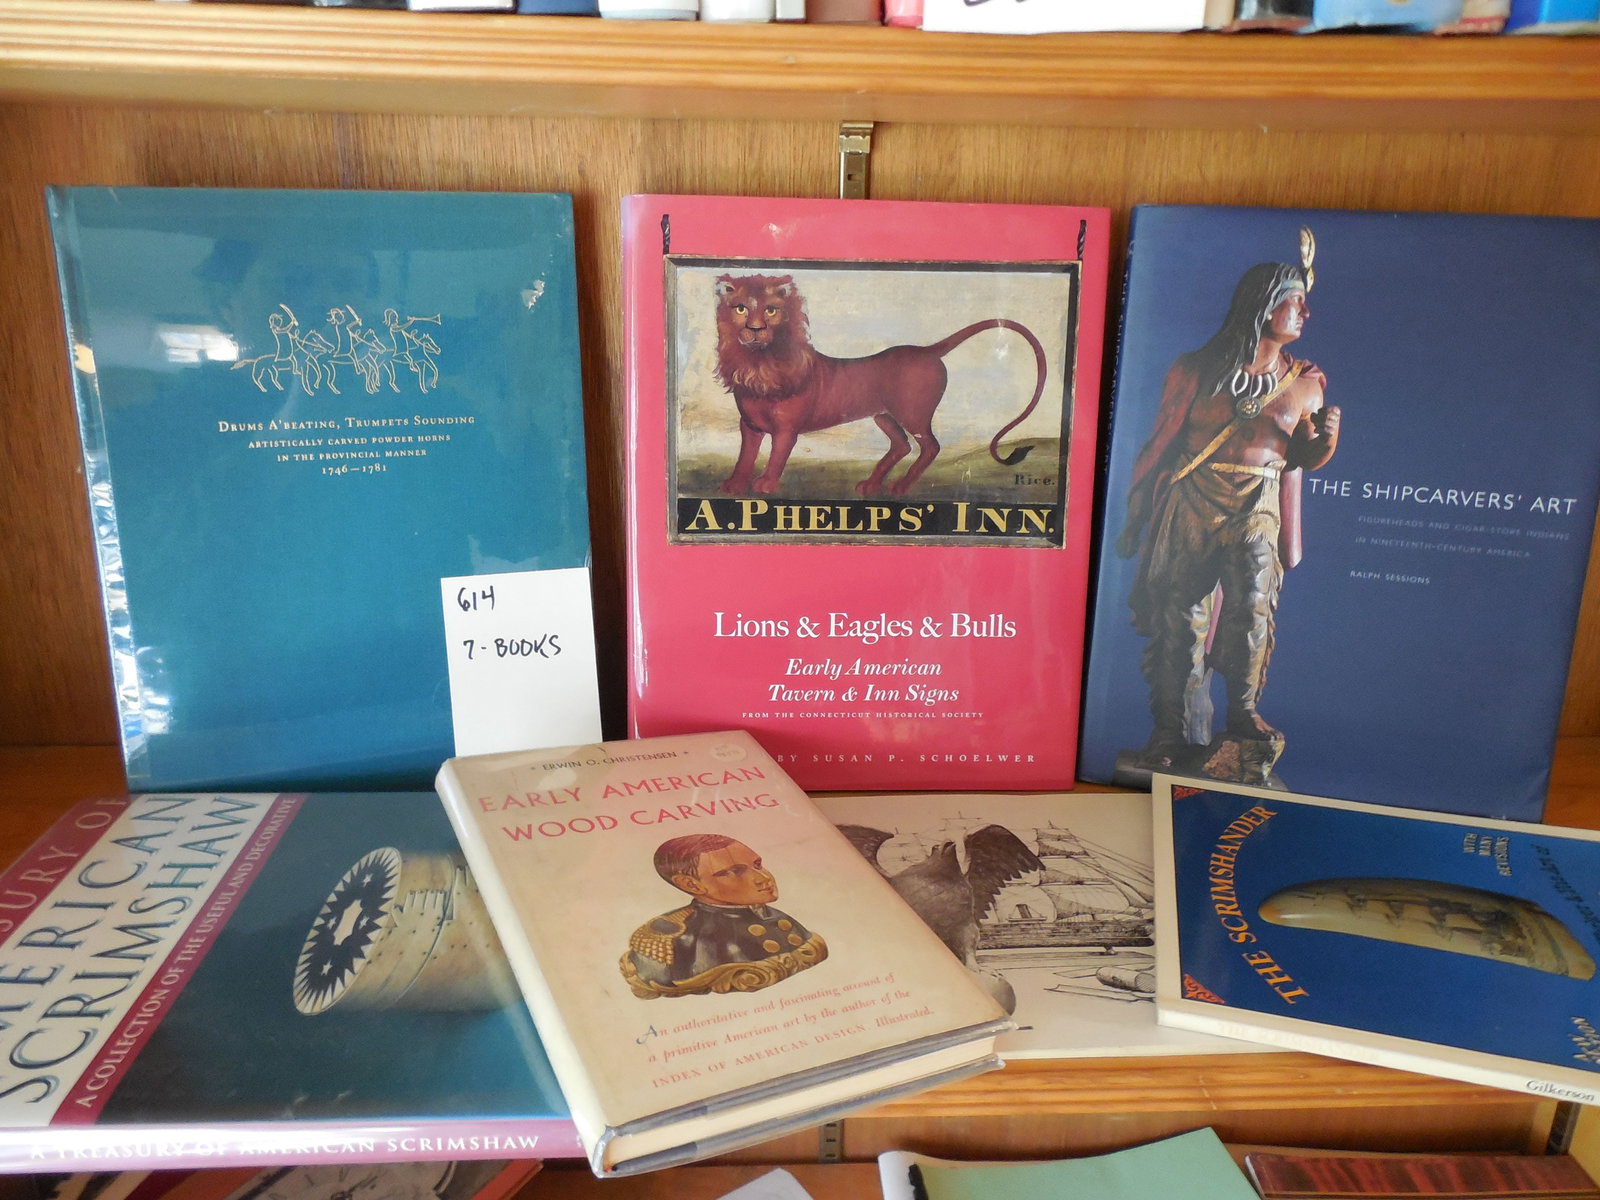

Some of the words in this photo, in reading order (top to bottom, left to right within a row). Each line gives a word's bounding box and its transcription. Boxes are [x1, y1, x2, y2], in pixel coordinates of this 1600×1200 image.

[217, 420, 264, 433] DRUMS
[344, 415, 409, 428] TRUMPETS
[413, 414, 476, 427] SOUNDING
[248, 438, 324, 449] ARTISTICALLY
[327, 436, 368, 446] CARVED
[372, 435, 414, 444] POWDER
[417, 433, 451, 442] HORNS
[276, 453, 289, 463] IN
[293, 452, 315, 462] THE
[319, 450, 381, 460] PROVINCIAL
[385, 448, 427, 458] MANNER
[1014, 473, 1056, 486] Rice.
[1308, 478, 1352, 497] THE
[1361, 482, 1523, 512] SHIPCARVERS'
[1529, 496, 1579, 516] ART
[951, 500, 1056, 535] INN.
[1428, 521, 1449, 531] AND
[1355, 536, 1366, 545] IN
[1486, 548, 1532, 559] AMERICA
[1349, 569, 1382, 580] RALPH
[1385, 572, 1431, 585] SESSIONS
[457, 585, 496, 612] 614
[713, 611, 790, 638] Lions
[796, 615, 821, 639] &
[827, 612, 914, 645] Eagles
[919, 615, 944, 639] &
[949, 612, 1018, 639] Bulls
[785, 658, 843, 681] Early
[844, 658, 943, 677] American
[768, 684, 836, 702] Tavern
[841, 686, 858, 702] &
[863, 684, 901, 702] Inn
[904, 684, 960, 706] Signs
[742, 711, 770, 719] FROM
[774, 711, 795, 719] THE
[799, 711, 871, 719] CONNECTICUT
[875, 711, 937, 719] HISTORICAL
[941, 711, 985, 719] SOCIETY
[542, 759, 583, 772] ERWIN
[603, 751, 679, 765] CHRISTENSEN
[776, 754, 799, 763] BY
[812, 754, 874, 763] SUSAN
[888, 754, 905, 763] P.
[919, 754, 1036, 764] SCHOELWER
[478, 786, 582, 814] EARLY
[602, 766, 767, 800] AMERICAN
[247, 797, 298, 862] DECORATIVE
[502, 815, 619, 842] WOOD
[629, 793, 780, 826] CARVING
[227, 863, 253, 890] AND
[1208, 805, 1279, 943] SCRIMSHANDER
[198, 887, 238, 935] USEFUL
[177, 932, 208, 966] THE
[160, 962, 186, 986] OF
[1242, 950, 1310, 1005] THE
[636, 1024, 669, 1046] An
[672, 1008, 749, 1036] authoritative
[753, 1000, 776, 1014] and
[778, 986, 842, 1010] fascinating
[842, 975, 881, 993] account
[884, 971, 896, 985] of
[647, 1054, 657, 1064] a
[662, 1039, 719, 1064] primitive
[723, 1023, 779, 1045] American
[783, 1017, 801, 1031] art
[803, 1011, 817, 1025] by
[820, 1007, 837, 1019] the
[841, 998, 878, 1015] author
[880, 993, 892, 1006] of
[894, 988, 911, 1000] the
[85, 1000, 162, 1091] COLLECTION
[651, 1067, 702, 1089] INDEX
[708, 1060, 728, 1073] OF
[734, 1039, 810, 1067] AMERICAN
[873, 1006, 936, 1028] Illustrated.
[74, 1090, 99, 1109] A
[1526, 1080, 1595, 1102] Gilkerson
[387, 1135, 540, 1152] SCRIMSHAW
